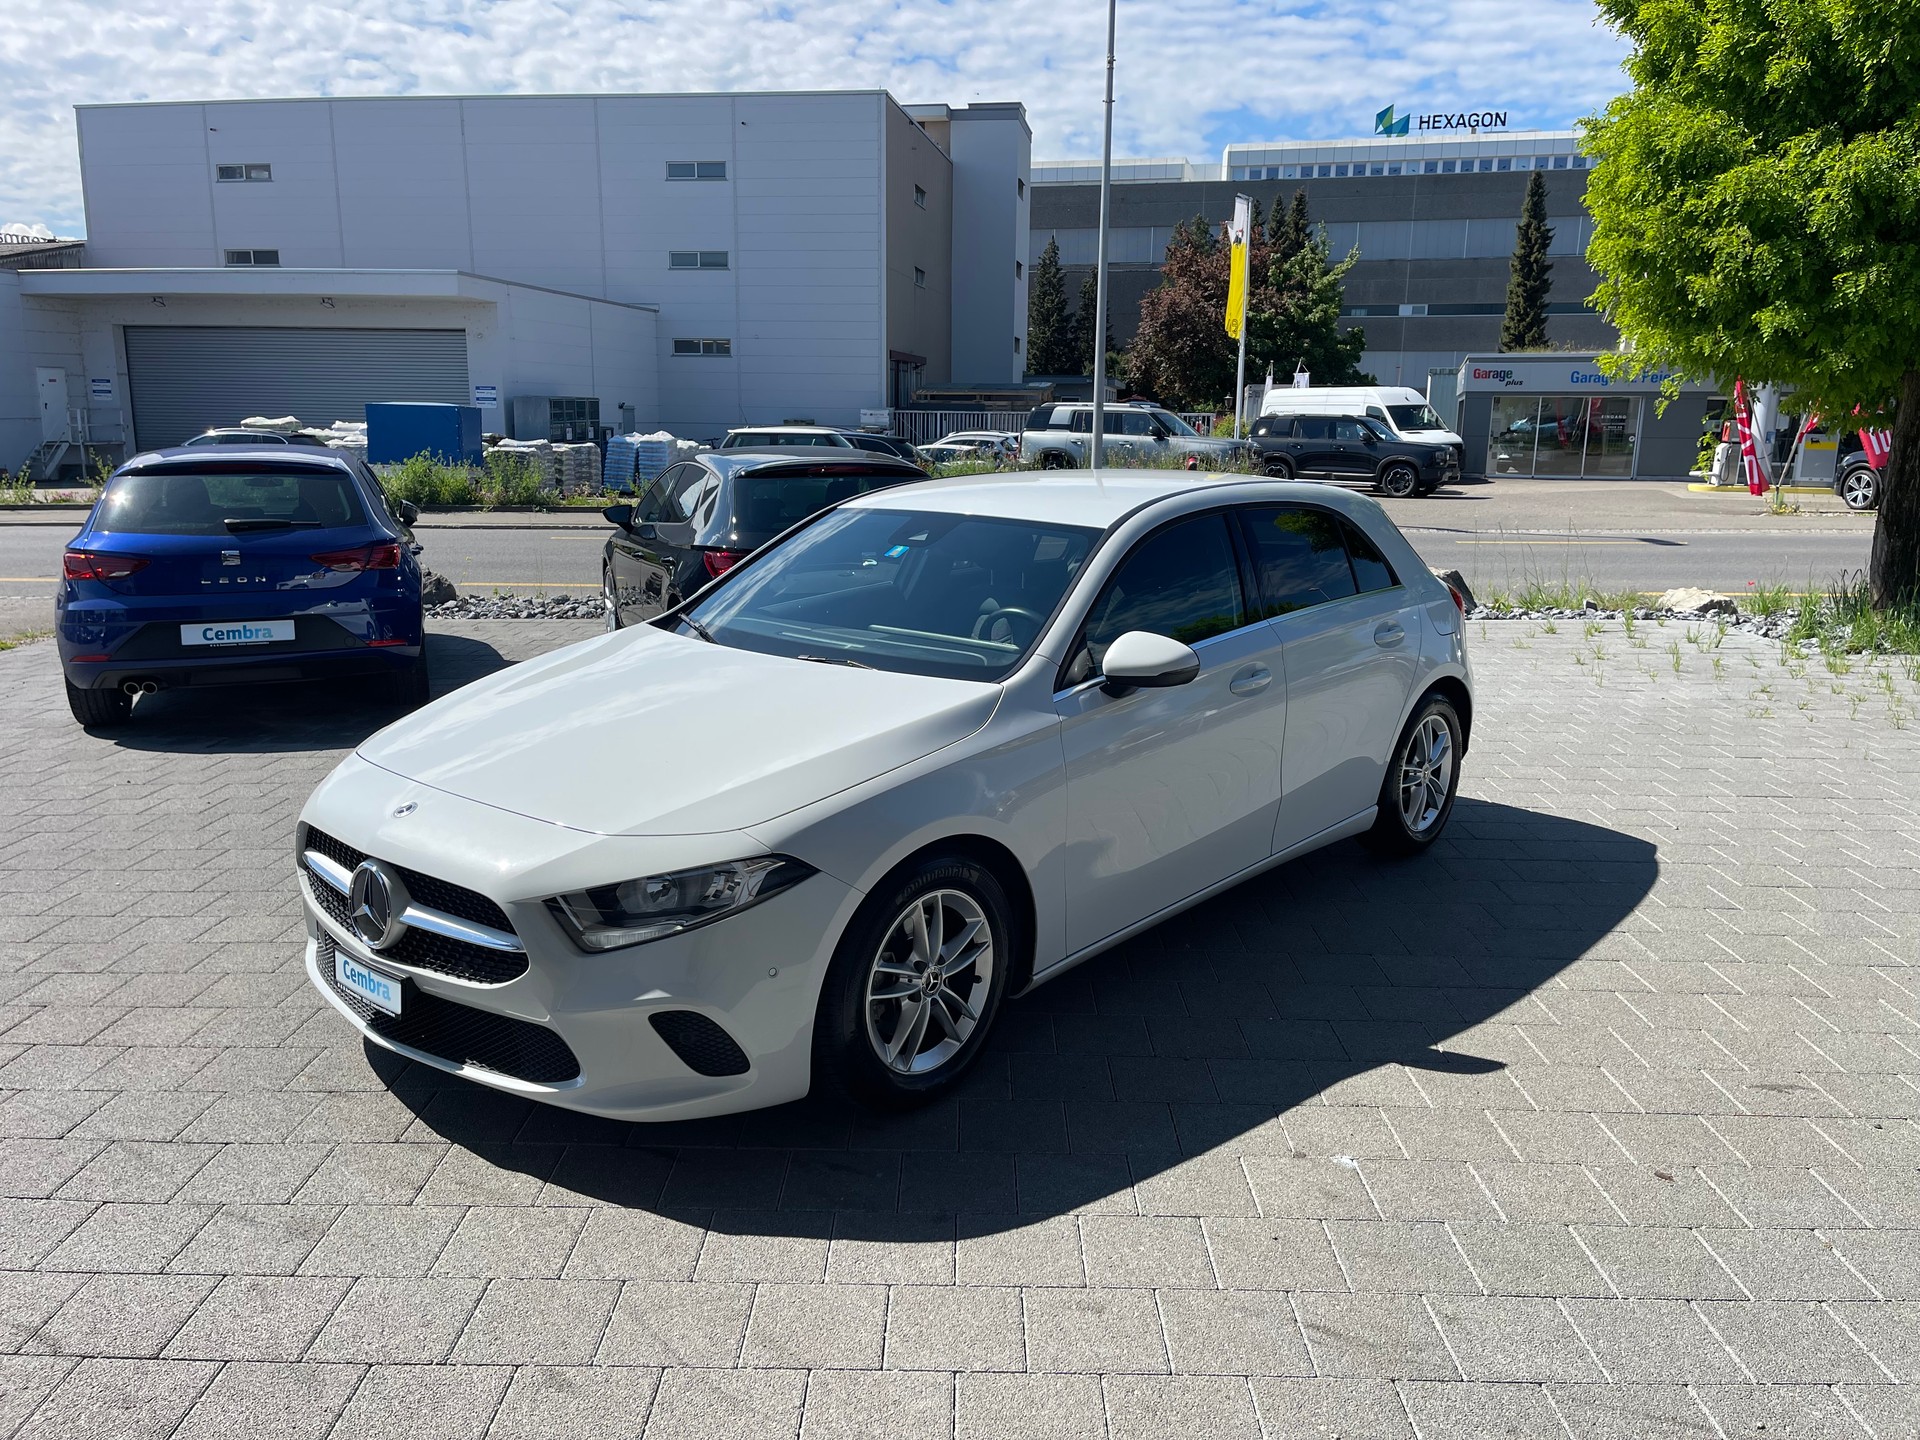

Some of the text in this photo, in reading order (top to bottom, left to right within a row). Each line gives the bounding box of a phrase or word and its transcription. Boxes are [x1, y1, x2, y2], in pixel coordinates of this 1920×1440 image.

[1418, 112, 1507, 130] HEXAGON
[1473, 368, 1513, 382] Garage
[1505, 379, 1524, 387] plus
[201, 576, 267, 584] LEON
[202, 625, 274, 641] Cembra
[343, 959, 391, 1002] Cembra
